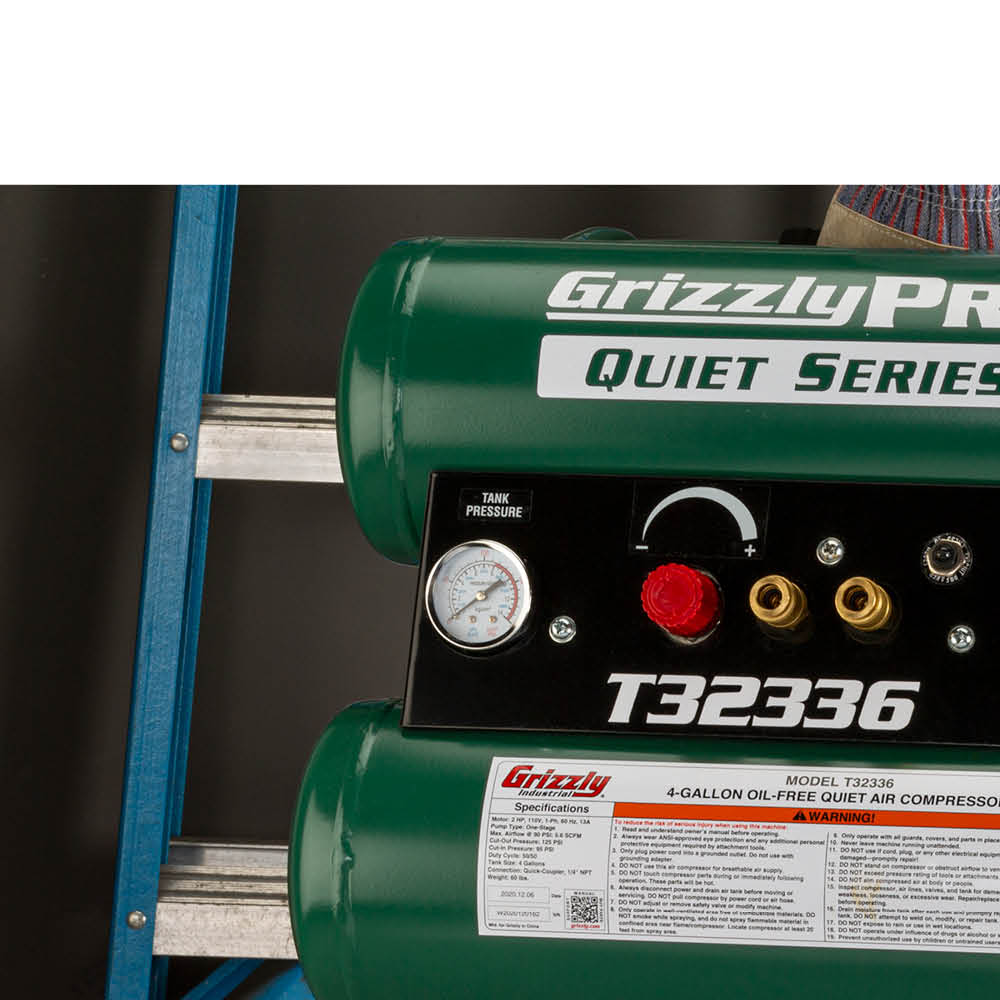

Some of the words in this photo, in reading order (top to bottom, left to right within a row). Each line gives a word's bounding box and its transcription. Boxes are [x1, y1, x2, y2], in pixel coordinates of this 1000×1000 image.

[585, 349, 769, 392] QUIET
[482, 492, 510, 504] TANK
[466, 505, 523, 518] PRESSURE
[607, 673, 921, 731] T32336
[501, 765, 612, 798] Grizzly
[785, 775, 839, 787] MODEL
[844, 777, 894, 789] T32336
[518, 788, 573, 798] Industrial
[666, 787, 743, 800] 4-GALLON
[747, 789, 817, 802] OIL-FREE
[821, 791, 867, 804] QUIET
[870, 793, 896, 805] AIR
[514, 802, 590, 813] Specifications
[808, 811, 876, 823] WARNING!
